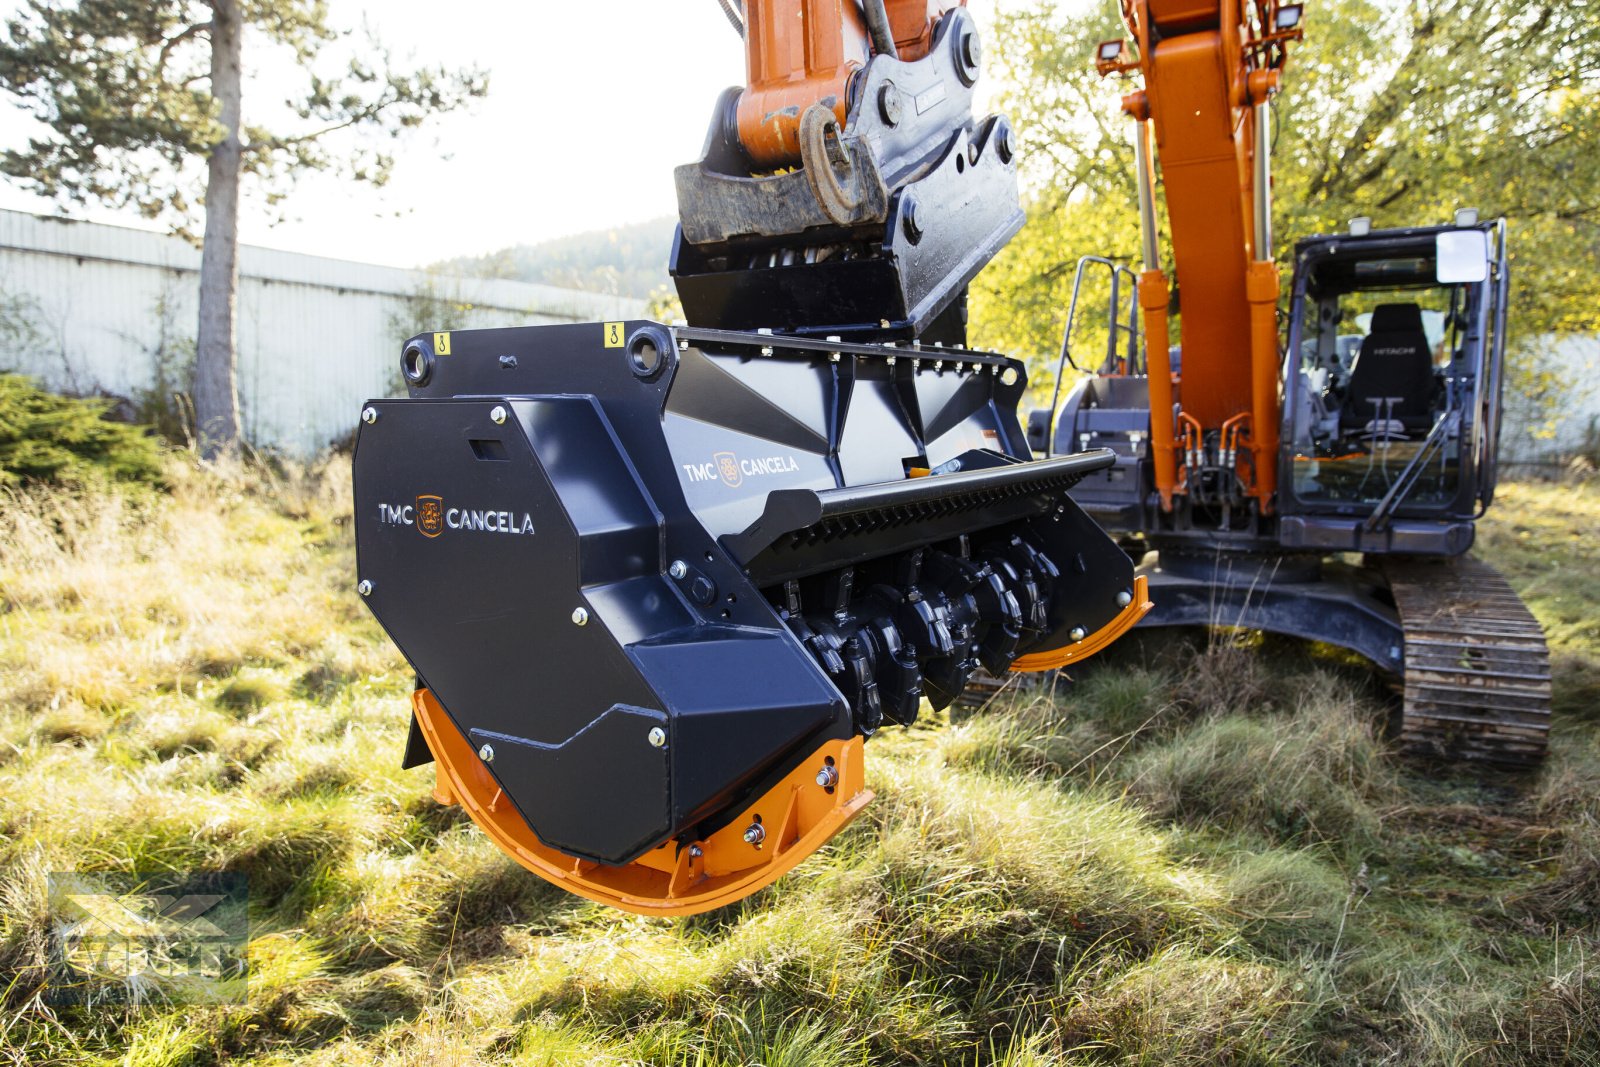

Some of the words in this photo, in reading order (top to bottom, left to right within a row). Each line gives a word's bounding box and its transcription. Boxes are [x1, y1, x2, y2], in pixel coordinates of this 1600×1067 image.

[1374, 347, 1415, 355] HITACHI
[683, 462, 717, 482] TMC
[741, 456, 800, 476] CANCELA
[378, 503, 414, 525] TMC
[446, 507, 535, 535] CANCELA
